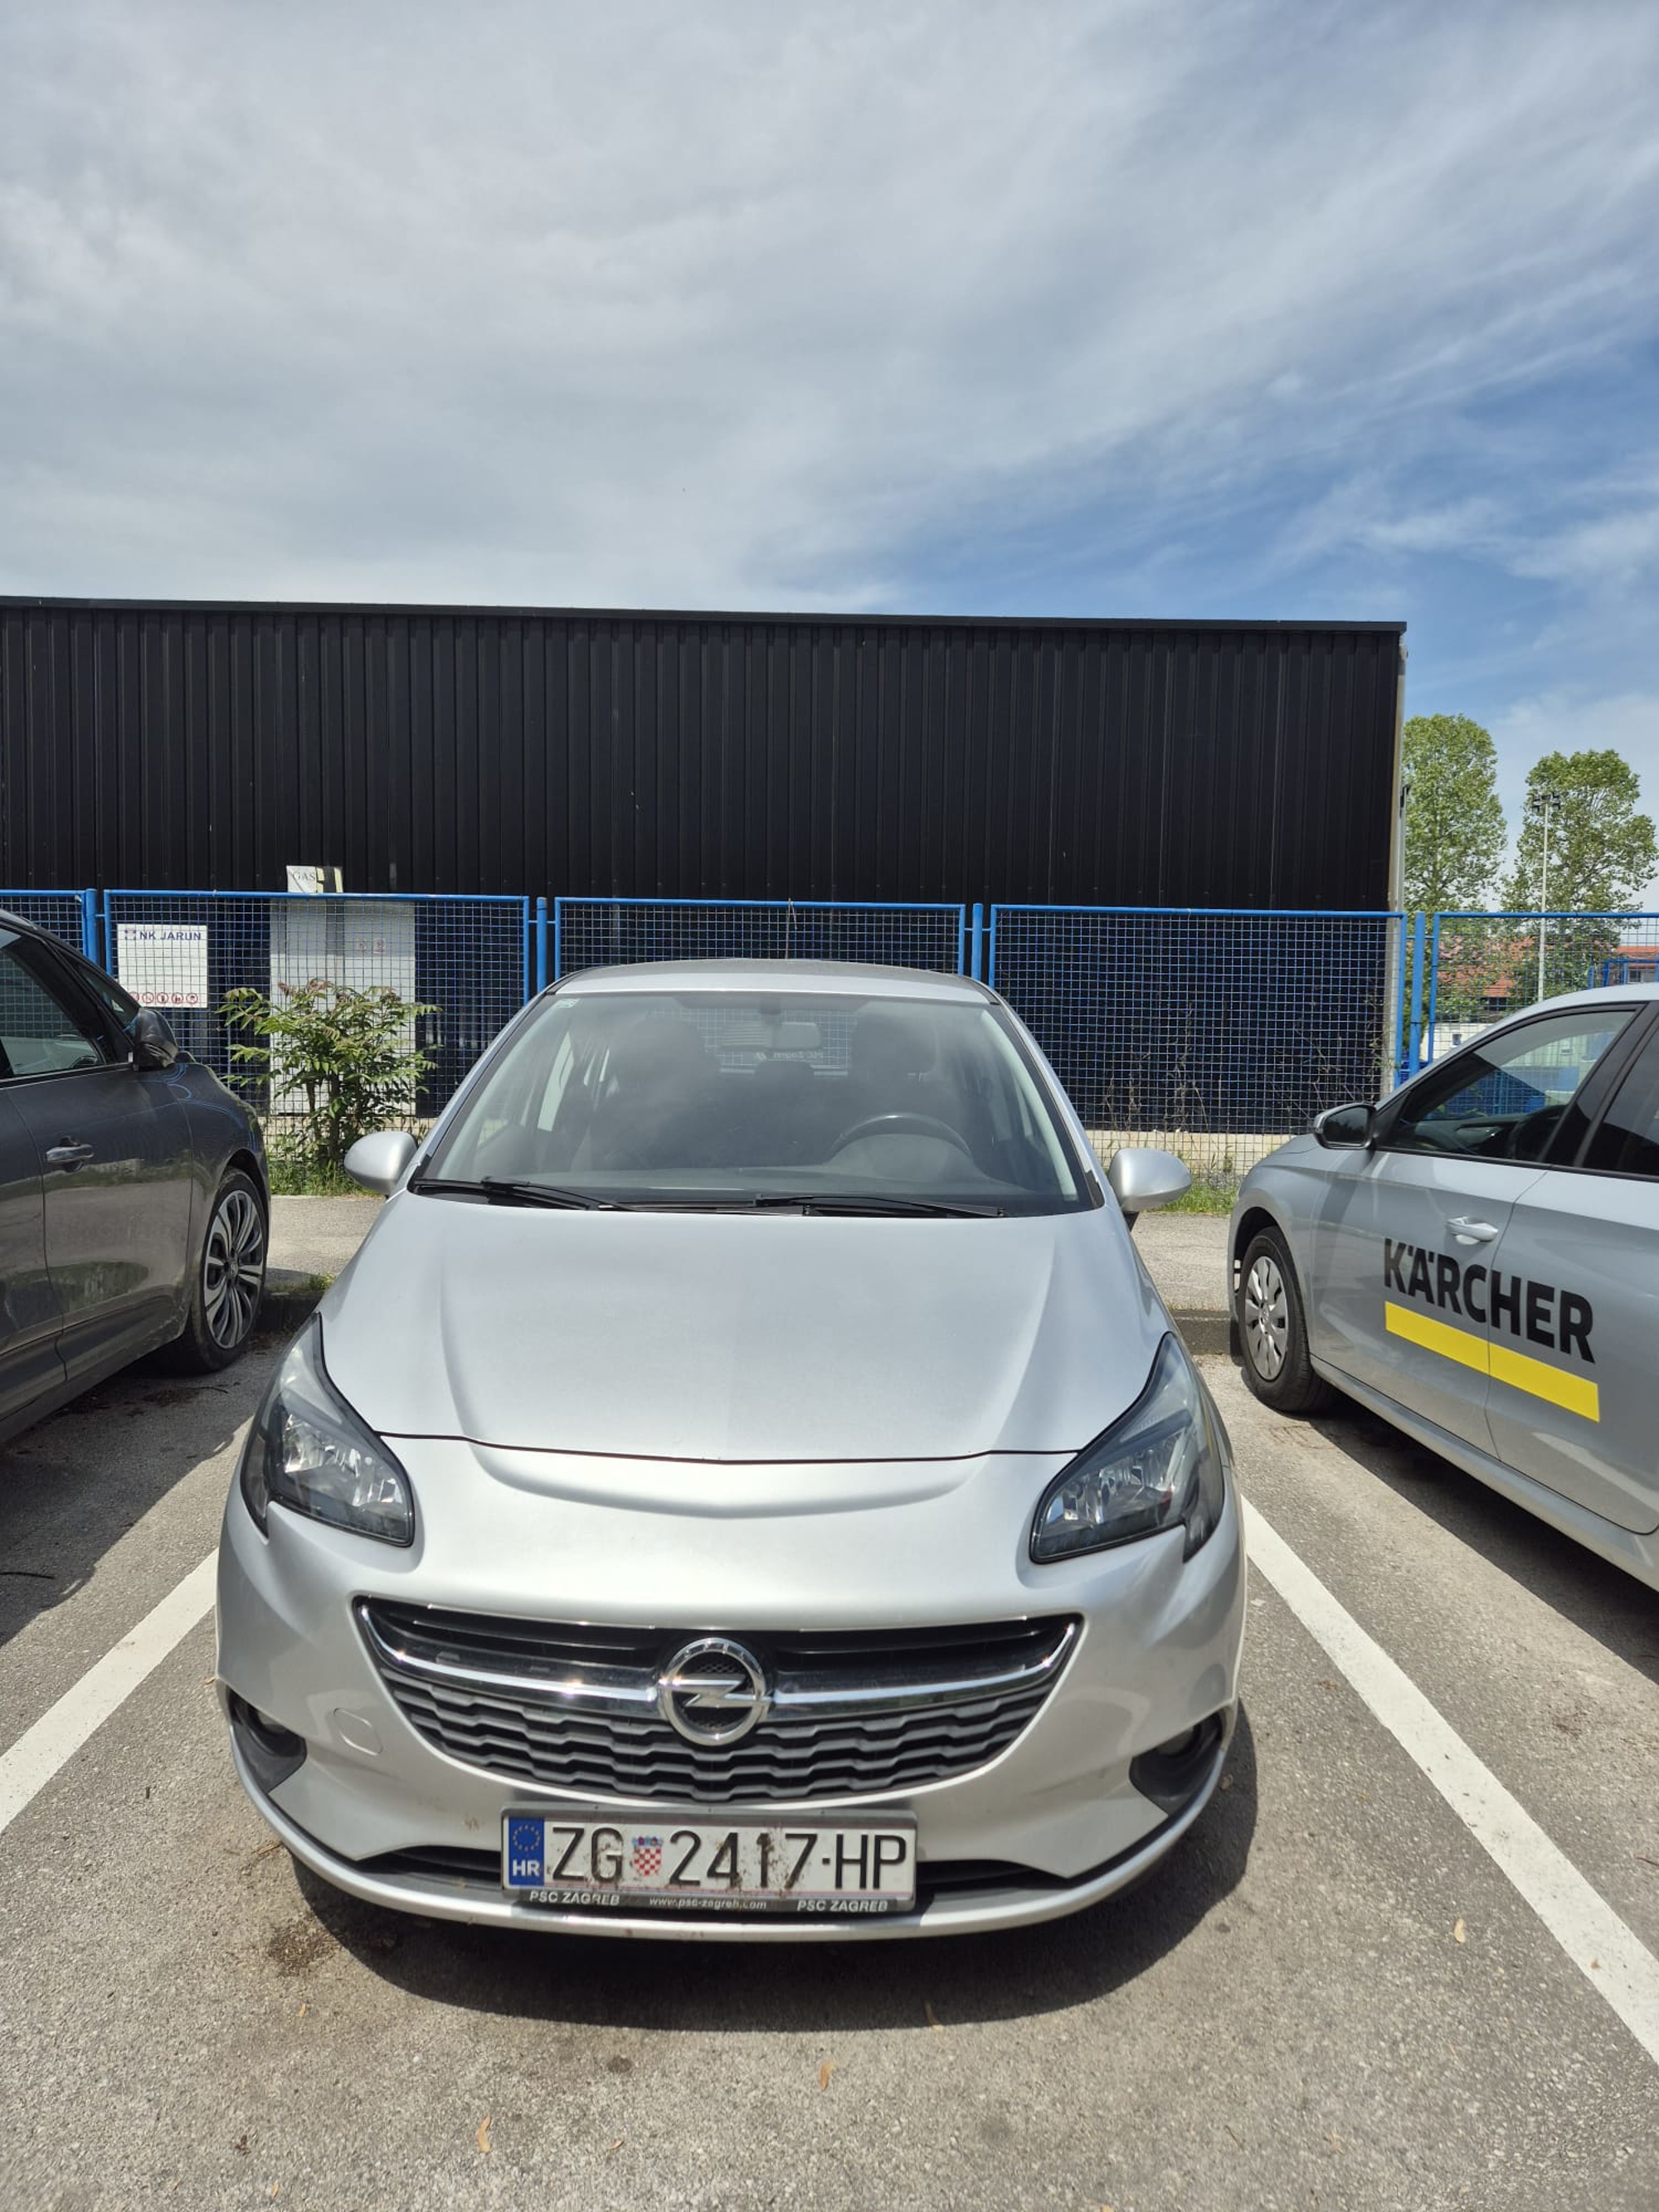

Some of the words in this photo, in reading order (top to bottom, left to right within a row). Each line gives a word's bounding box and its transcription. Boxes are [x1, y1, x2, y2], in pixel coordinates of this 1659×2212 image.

[139, 931, 156, 940] NK
[160, 932, 201, 941] JARUN
[1384, 1238, 1595, 1364] KÄRCHER
[552, 1827, 623, 1883] ZG
[512, 1860, 539, 1877] HR
[529, 1891, 558, 1903] PSC
[562, 1892, 620, 1906] ZAGREB
[797, 1899, 825, 1911] PSC
[830, 1900, 888, 1912] ZAGREB
